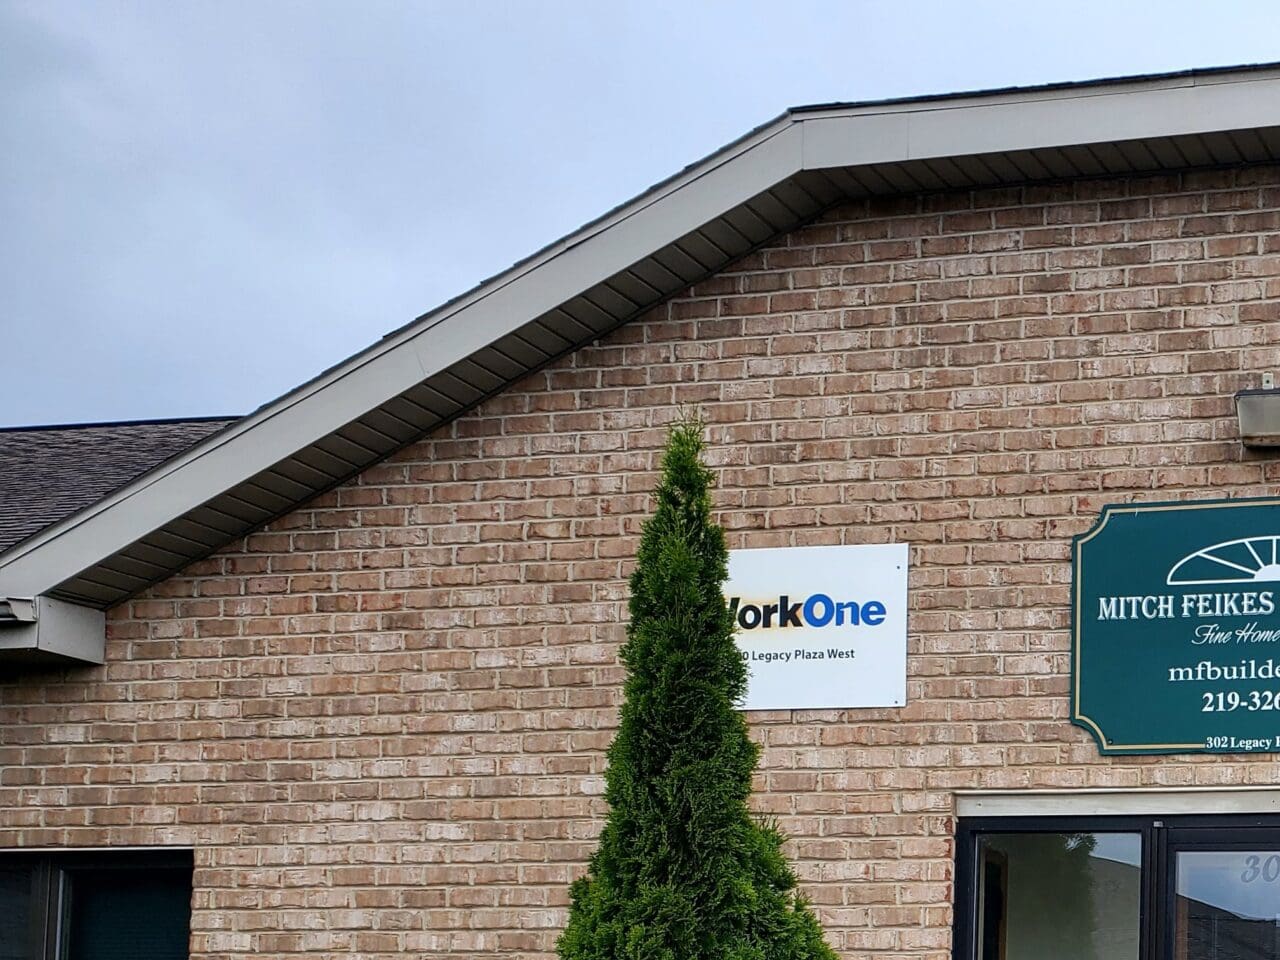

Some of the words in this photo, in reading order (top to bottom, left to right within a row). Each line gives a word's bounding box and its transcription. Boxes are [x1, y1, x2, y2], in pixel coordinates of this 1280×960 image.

[1097, 595, 1175, 621] MITCH
[1181, 591, 1275, 619] FEIKES
[1191, 624, 1232, 646] Fine
[1235, 621, 1280, 645] Home
[752, 650, 792, 663] Legacy
[794, 650, 825, 660] Plaza
[827, 649, 855, 660] West
[1206, 736, 1229, 748] 302
[1230, 736, 1273, 751] Legacy
